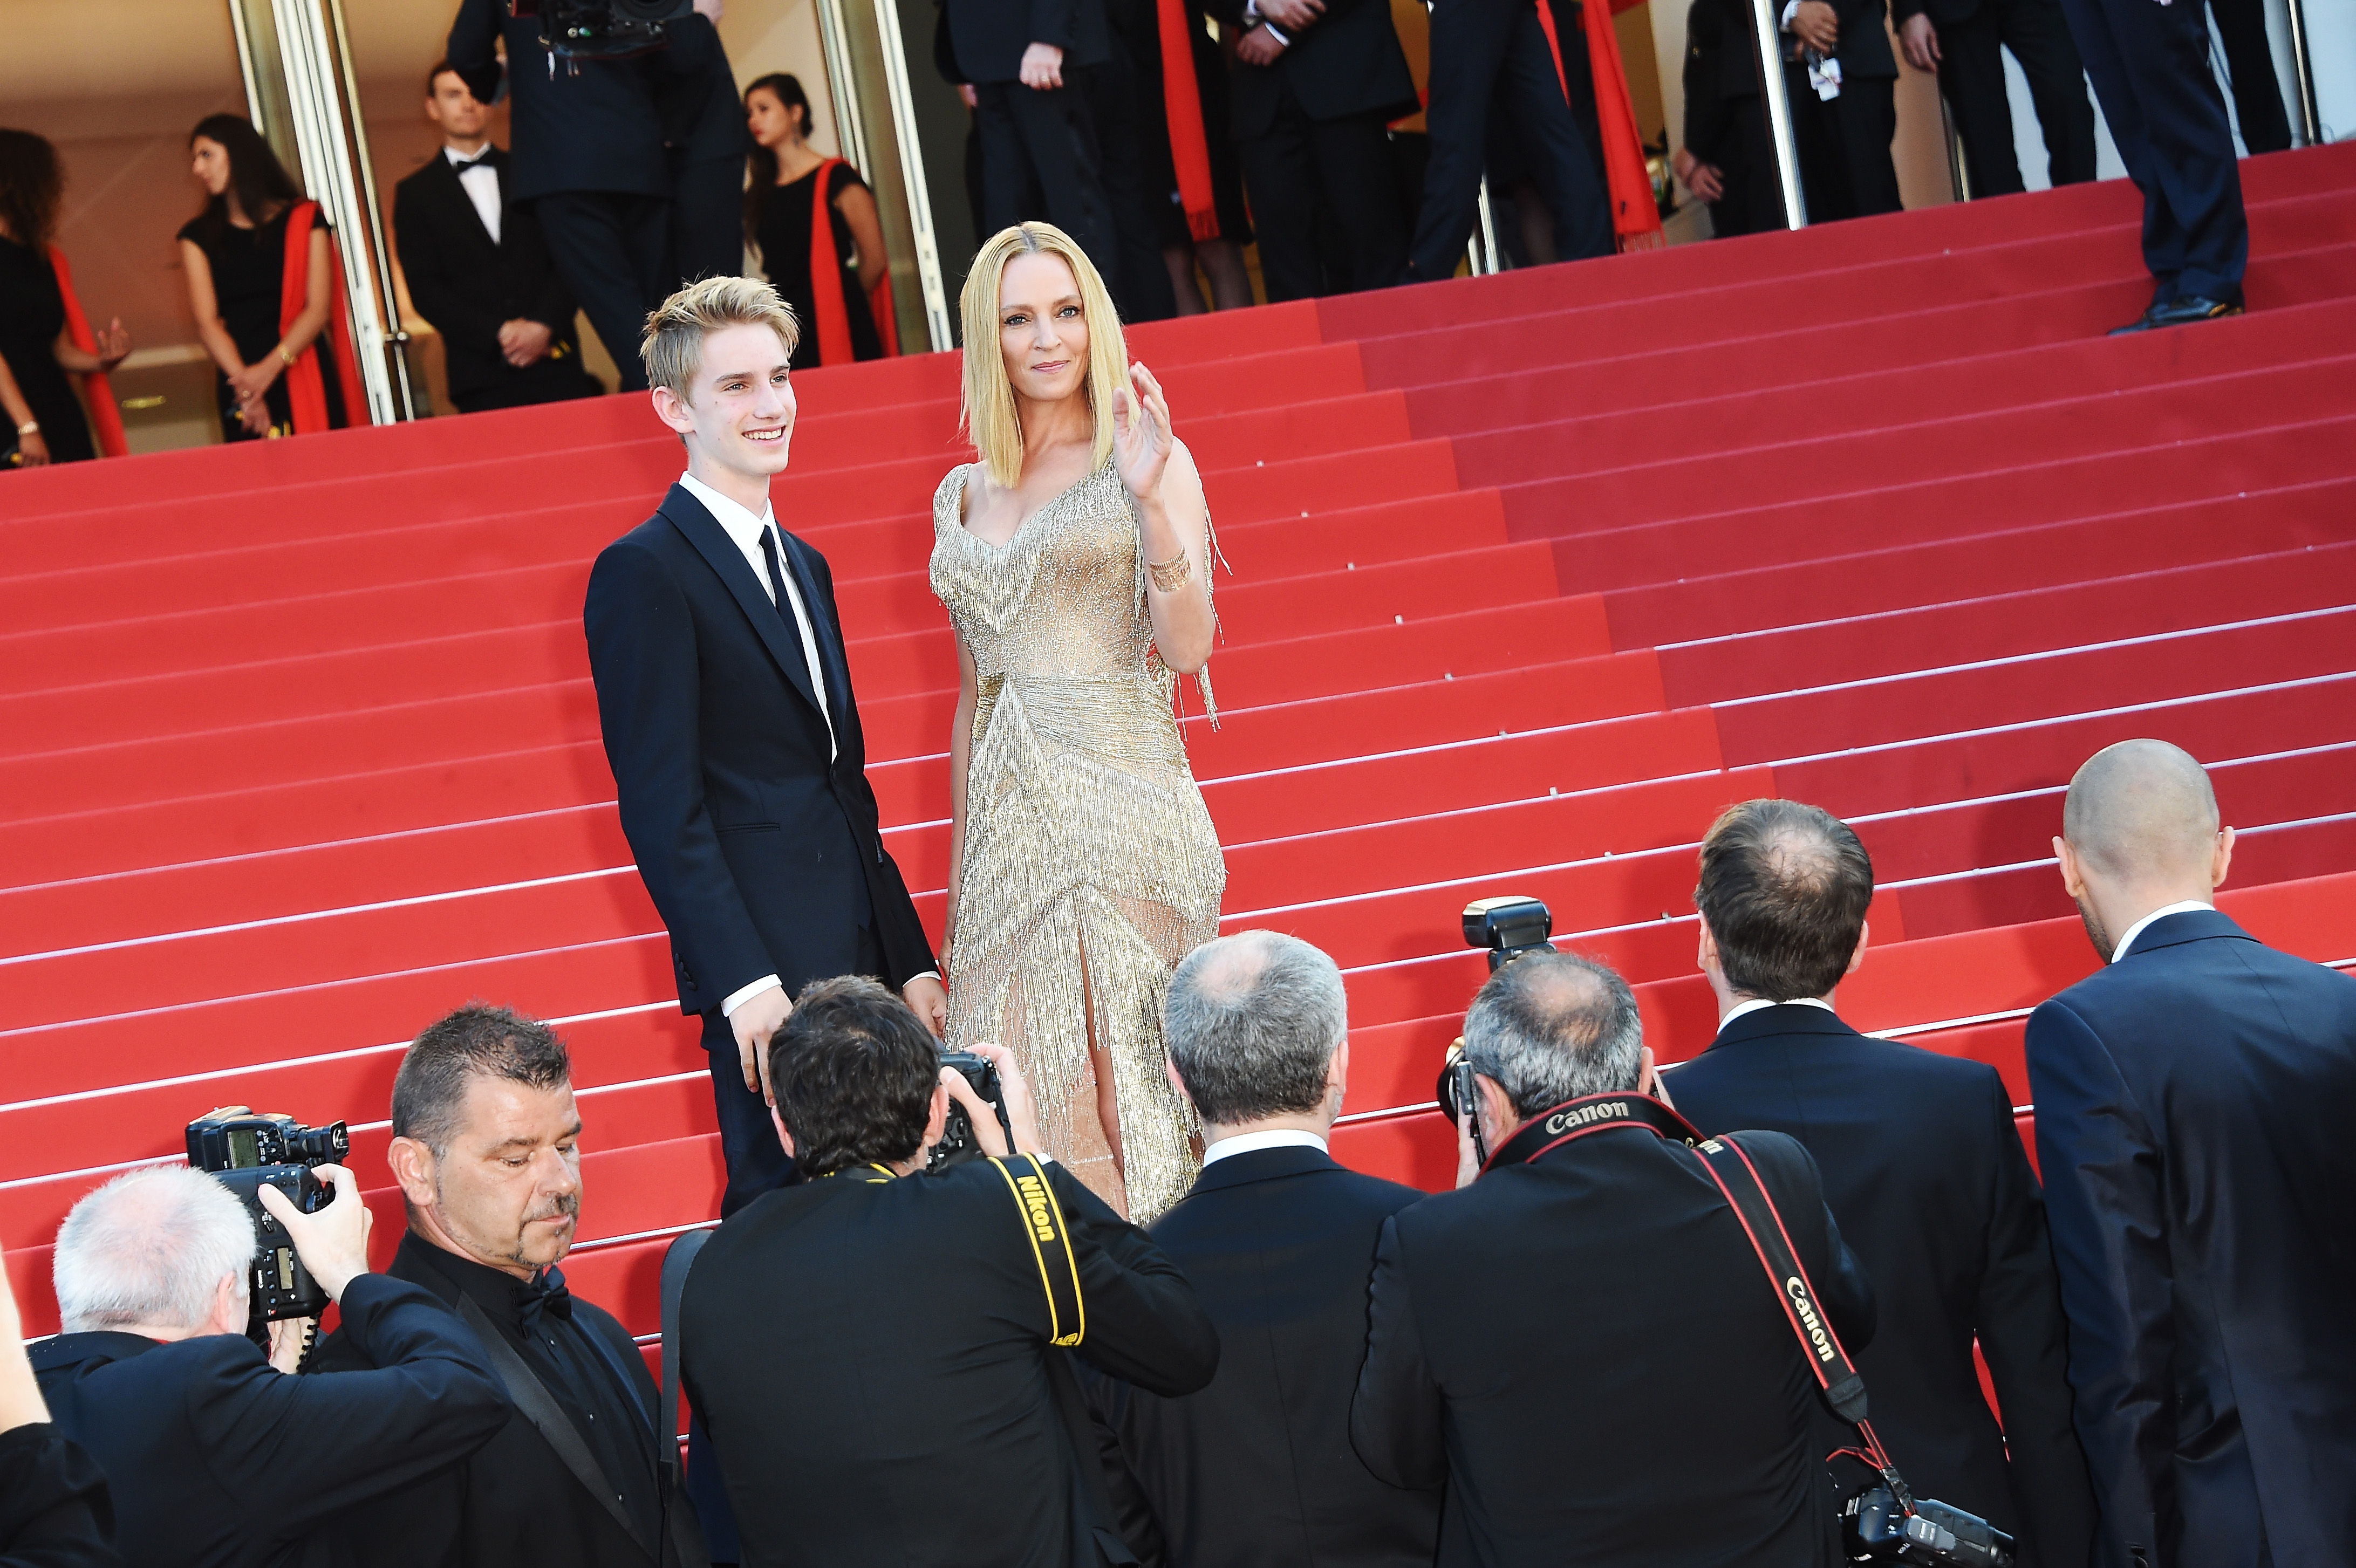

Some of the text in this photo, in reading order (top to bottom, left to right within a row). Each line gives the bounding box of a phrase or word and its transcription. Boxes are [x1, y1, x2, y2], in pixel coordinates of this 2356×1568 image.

[1546, 1101, 1629, 1134] Canon
[1017, 1176, 1055, 1242] Nikon
[1787, 1276, 1834, 1362] Canon
